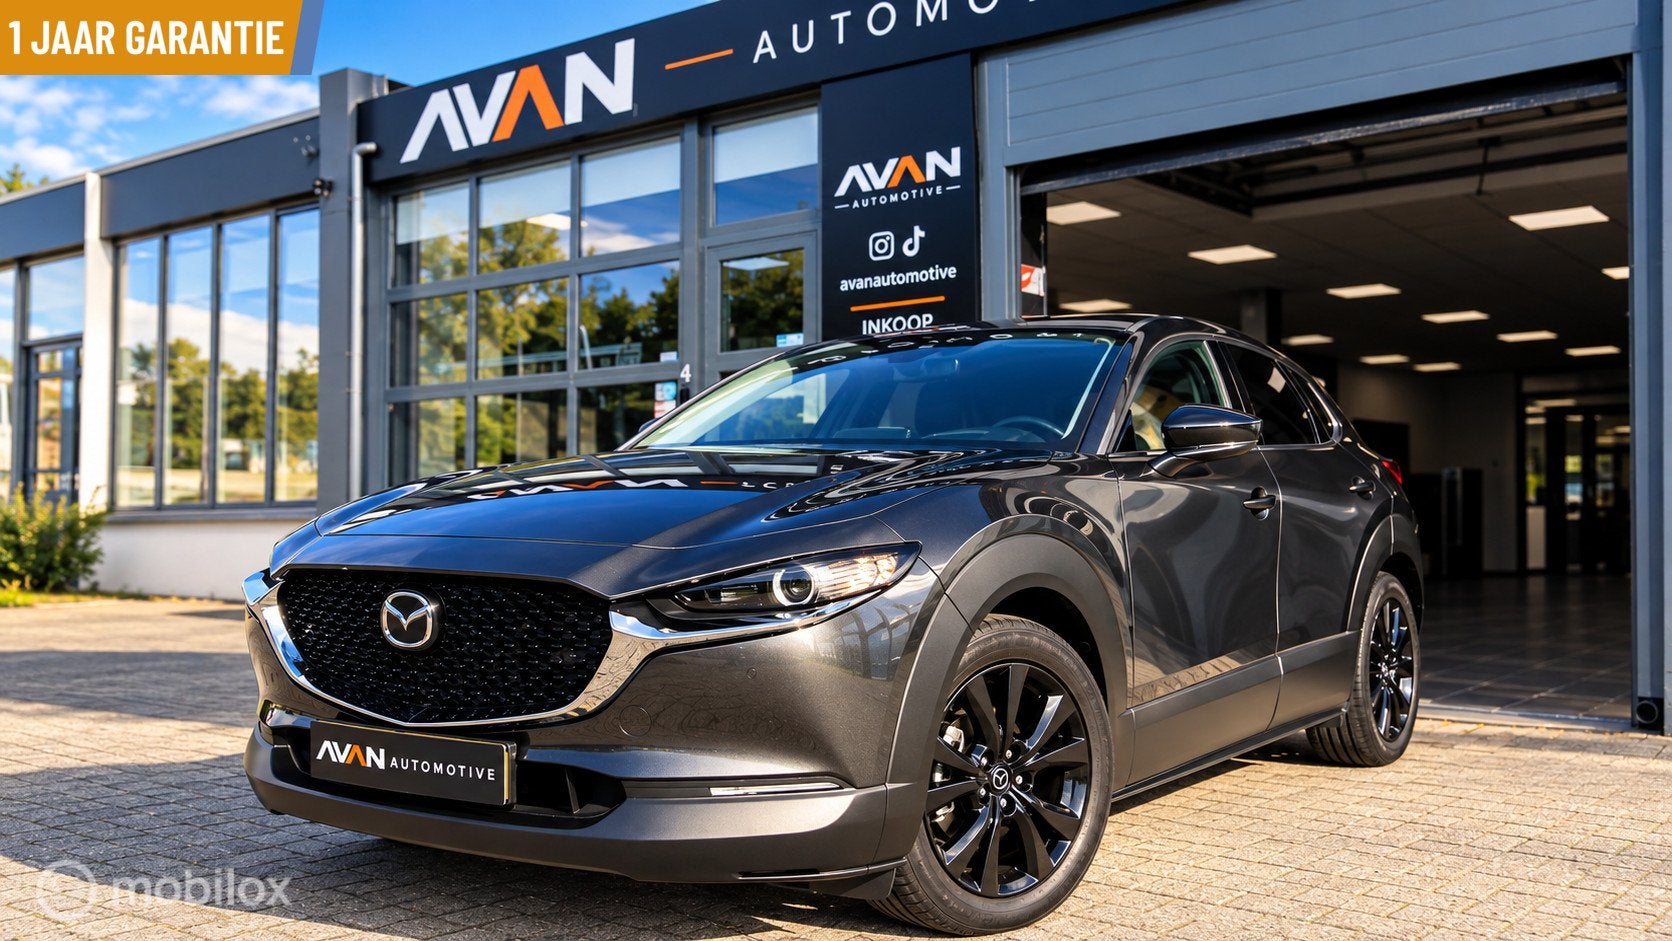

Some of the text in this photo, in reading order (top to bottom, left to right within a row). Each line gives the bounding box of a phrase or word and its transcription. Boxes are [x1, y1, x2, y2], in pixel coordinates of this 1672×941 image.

[400, 38, 635, 164] AVAN
[834, 146, 961, 197] AVAN
[852, 185, 943, 209] AUTOMOTIVE
[840, 264, 957, 292] avanautomotive
[862, 313, 933, 335] INKOOP
[680, 363, 692, 383] 4
[316, 740, 496, 781] AVAN AUTOMOTIVE
